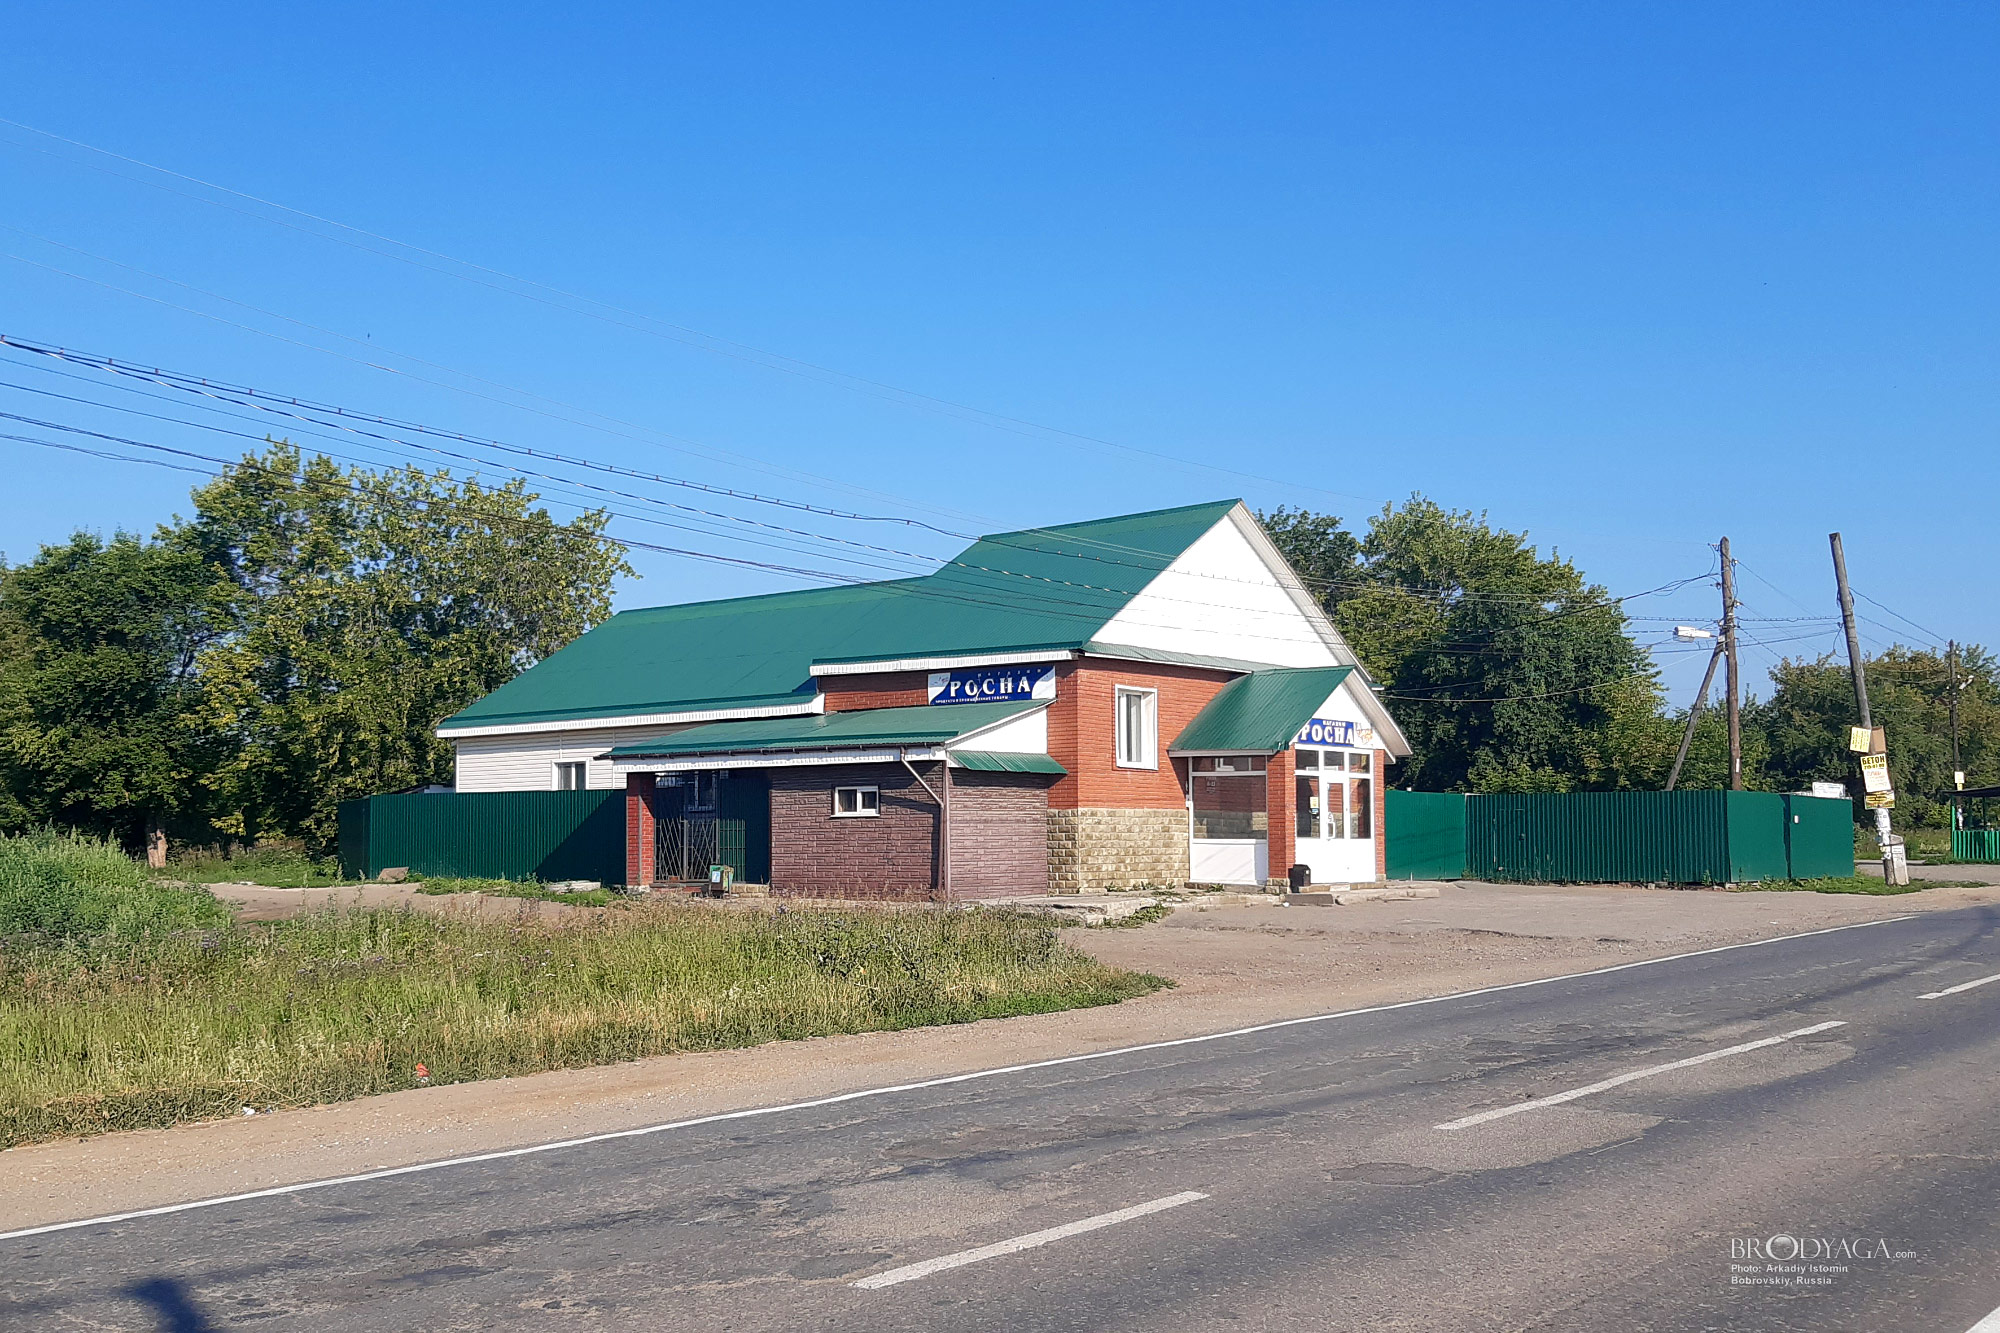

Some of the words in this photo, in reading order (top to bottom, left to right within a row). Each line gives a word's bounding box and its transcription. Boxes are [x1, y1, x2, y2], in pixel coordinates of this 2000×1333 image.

[950, 676, 1031, 697] РОСНА
[1300, 724, 1354, 744] РОСНА
[1861, 755, 1885, 765] БЕТОН
